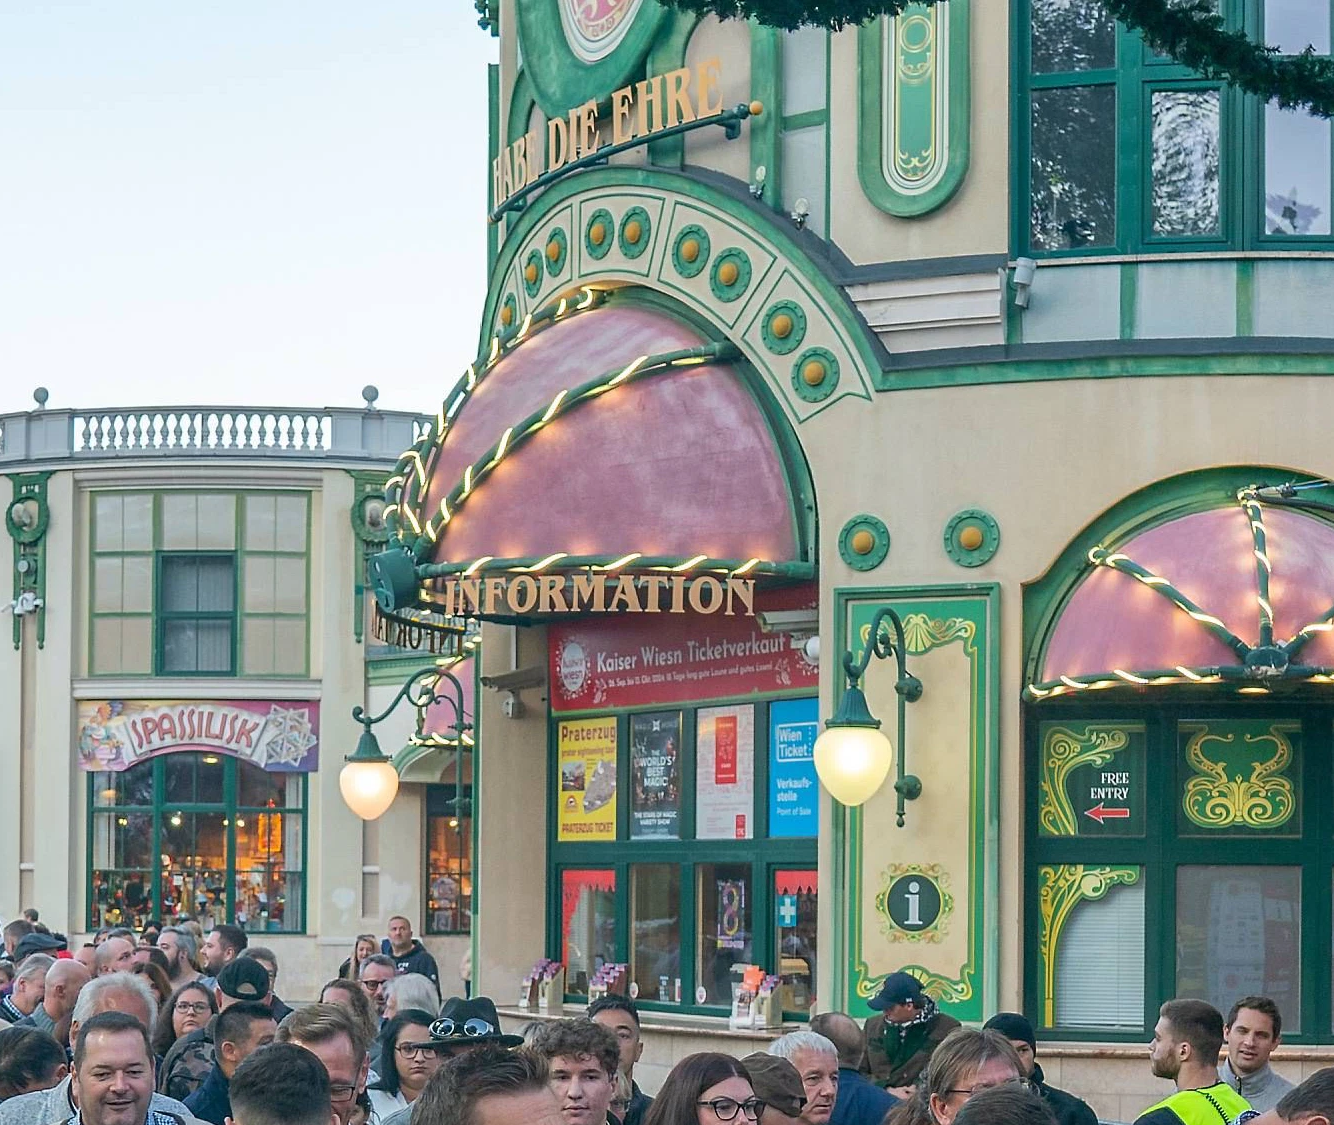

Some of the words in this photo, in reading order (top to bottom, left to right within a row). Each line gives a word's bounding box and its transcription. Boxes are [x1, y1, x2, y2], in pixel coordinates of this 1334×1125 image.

[548, 97, 600, 173] DIE
[611, 59, 724, 147] EHRE
[444, 574, 756, 616] INFORMATION
[597, 652, 637, 673] Kaiser
[640, 646, 682, 668] Wiesn
[131, 708, 260, 749] SPASSILISK
[561, 726, 616, 742] Praterzug
[779, 728, 802, 742] Wien
[779, 744, 808, 757] Ticket
[1101, 772, 1129, 785] FREE
[1091, 787, 1129, 800] ENTRY
